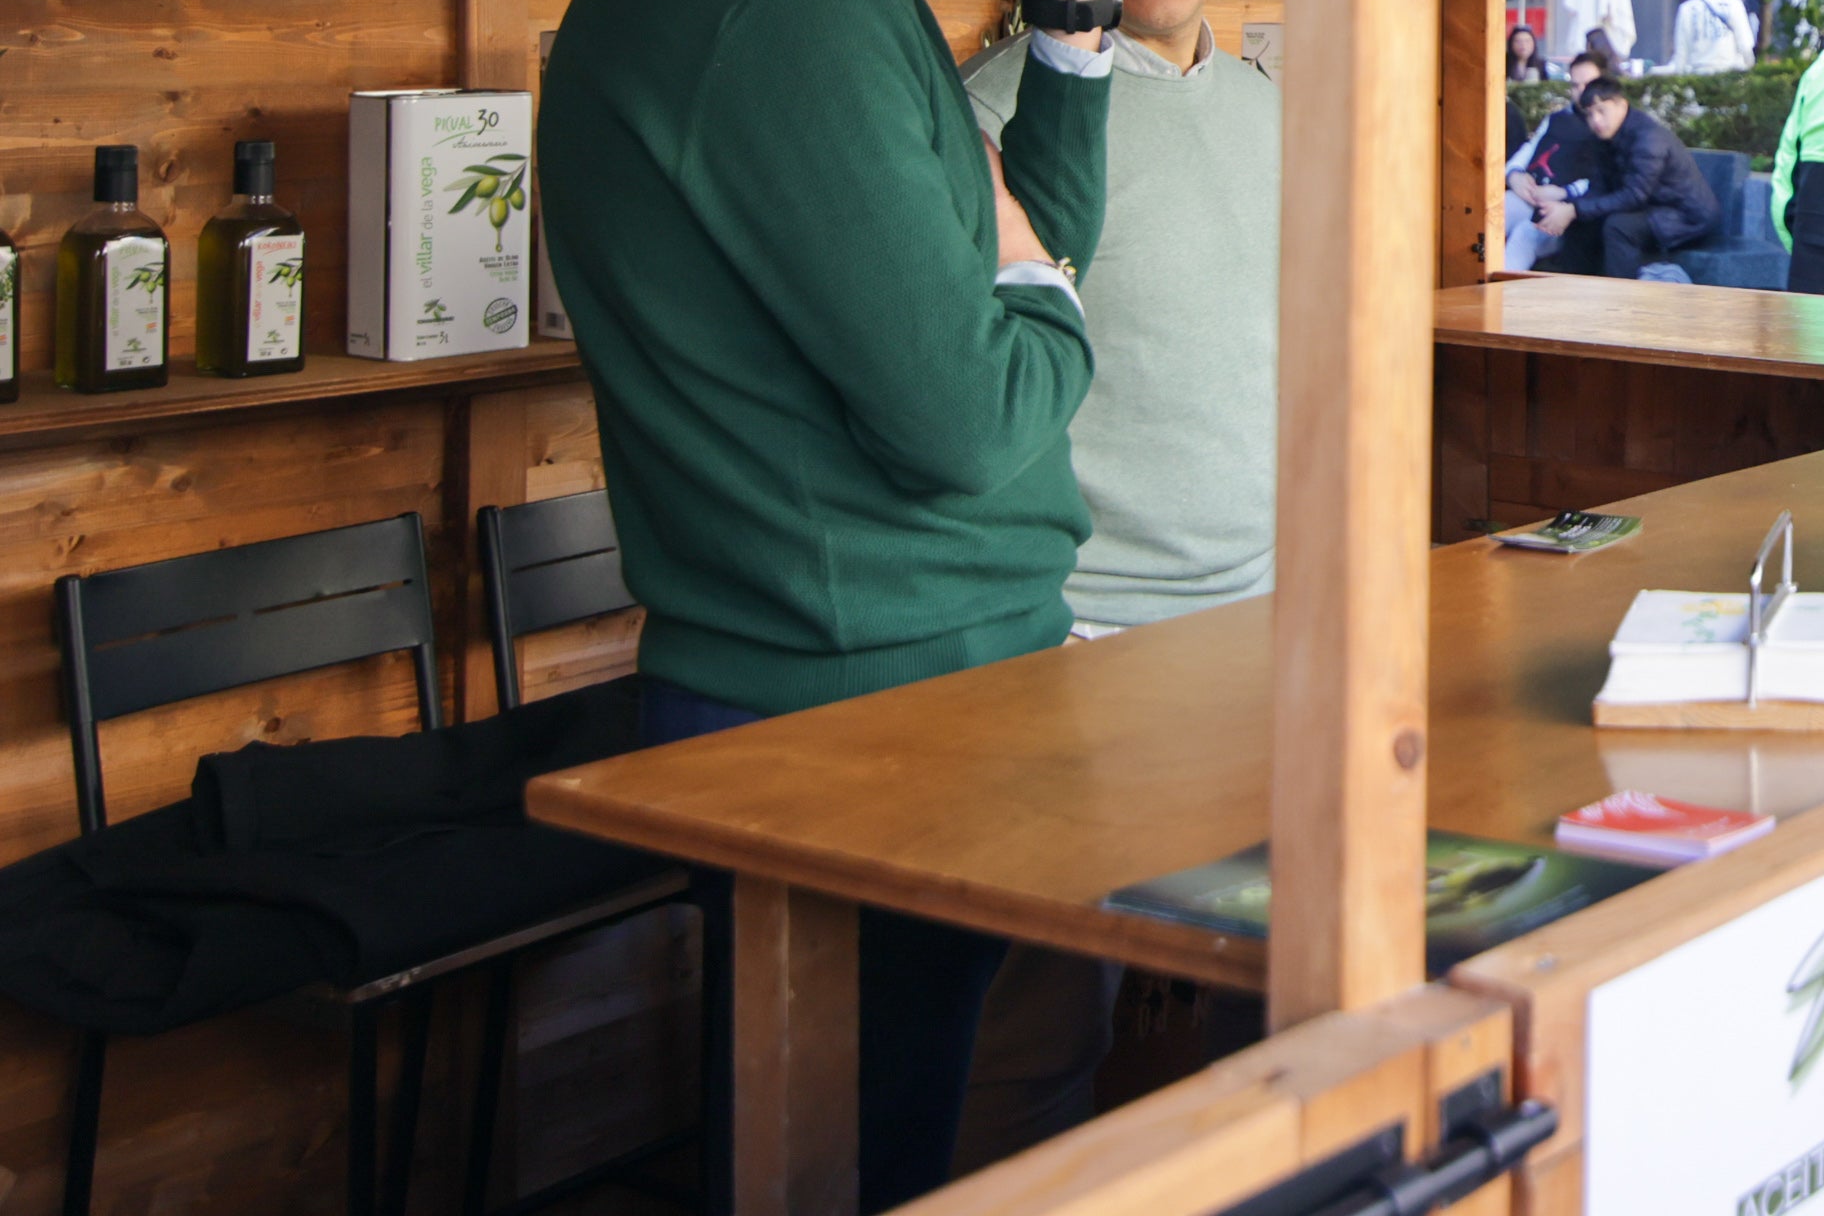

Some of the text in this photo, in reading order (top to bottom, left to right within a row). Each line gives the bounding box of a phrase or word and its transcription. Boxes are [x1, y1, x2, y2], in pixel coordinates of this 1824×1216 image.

[434, 109, 500, 135] PICUAL 30
[416, 156, 437, 290] el villar de la vega
